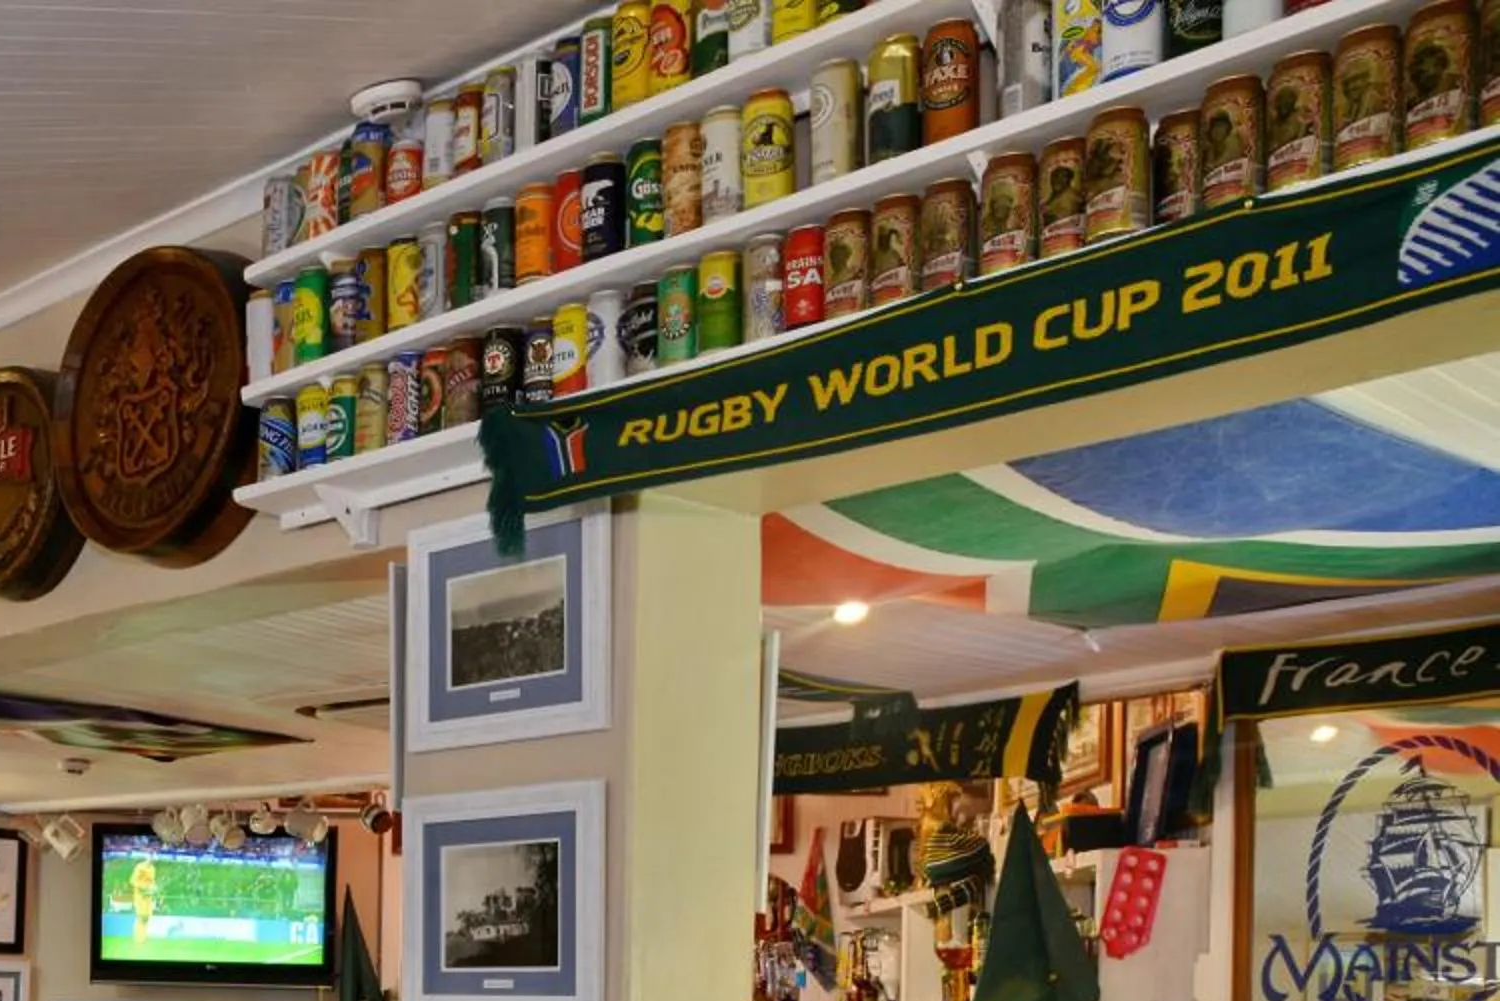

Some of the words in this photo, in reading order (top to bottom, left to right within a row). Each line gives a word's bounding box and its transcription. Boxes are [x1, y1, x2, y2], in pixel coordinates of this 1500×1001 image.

[583, 33, 599, 110] BORSODI
[787, 267, 822, 288] SA
[617, 383, 788, 447] RUGBY
[808, 321, 1013, 412] WORLD
[1033, 278, 1161, 351] CUP
[1181, 231, 1333, 314] 2011
[1257, 645, 1486, 706] France
